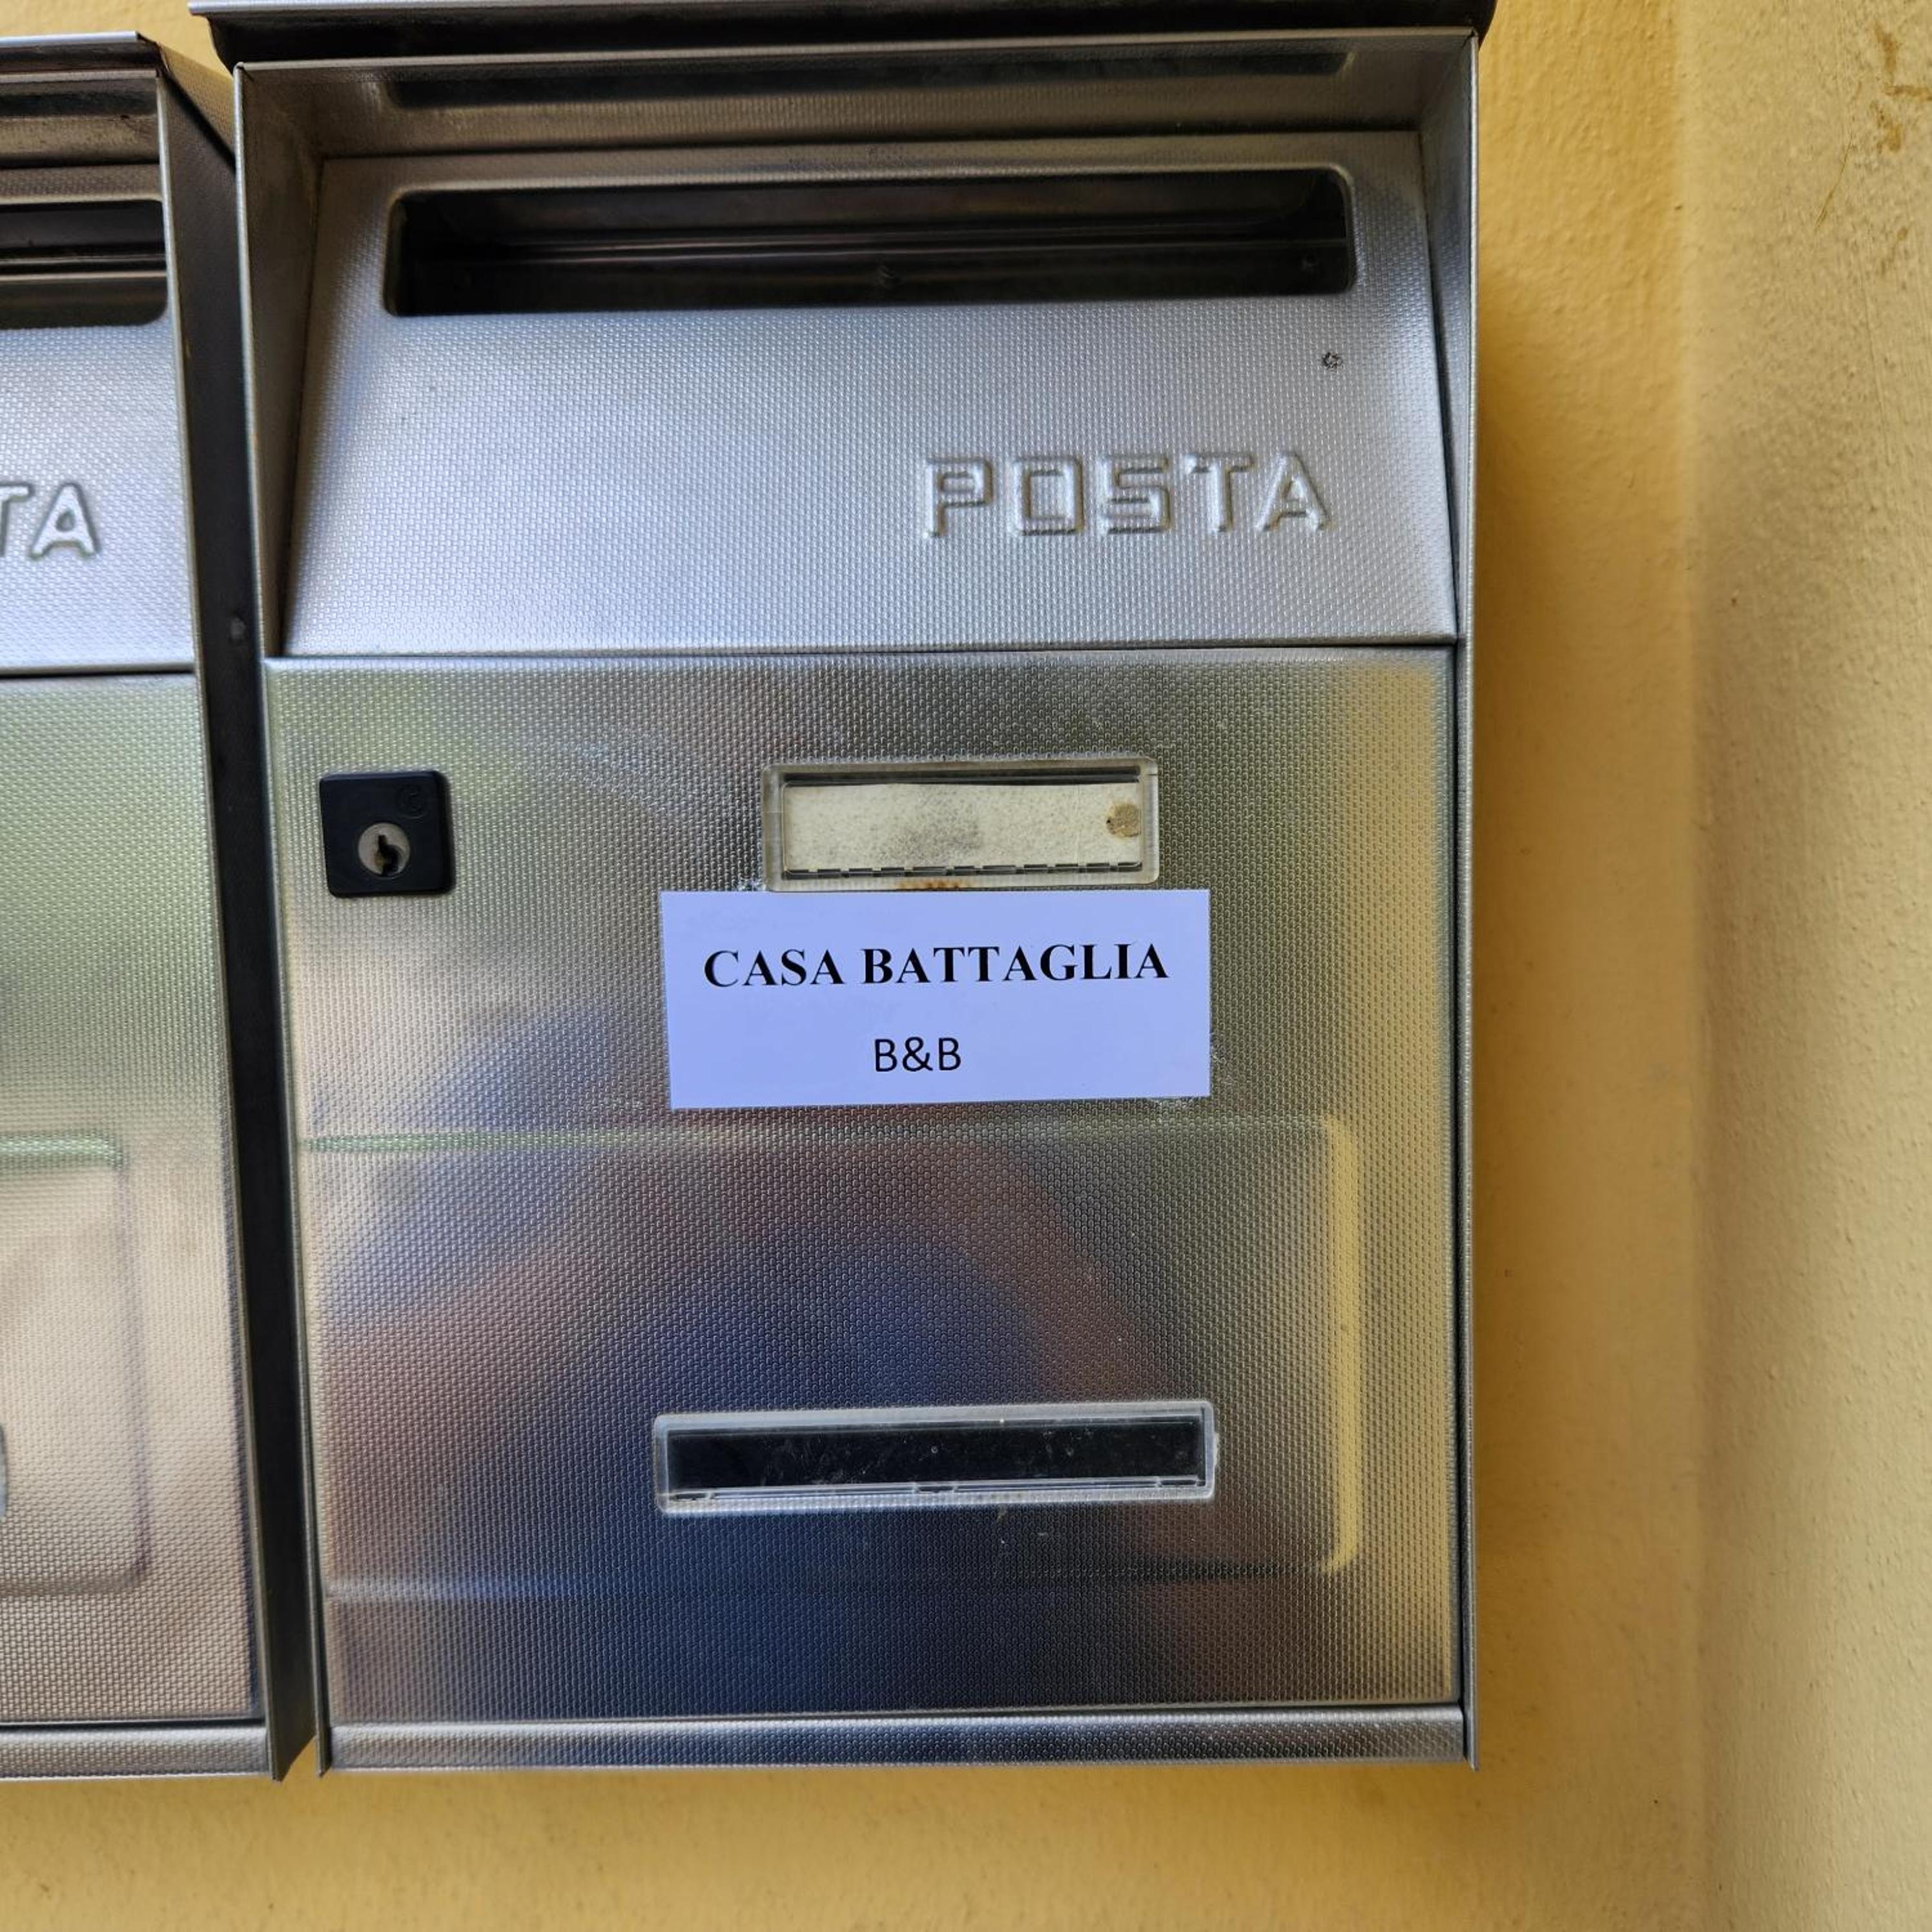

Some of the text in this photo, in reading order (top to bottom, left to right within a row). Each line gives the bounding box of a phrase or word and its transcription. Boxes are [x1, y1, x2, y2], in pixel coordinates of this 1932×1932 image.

[923, 452, 1333, 538] POSTA
[703, 943, 1170, 987] CASA BATTAGLIA
[874, 1036, 962, 1073] B&B
